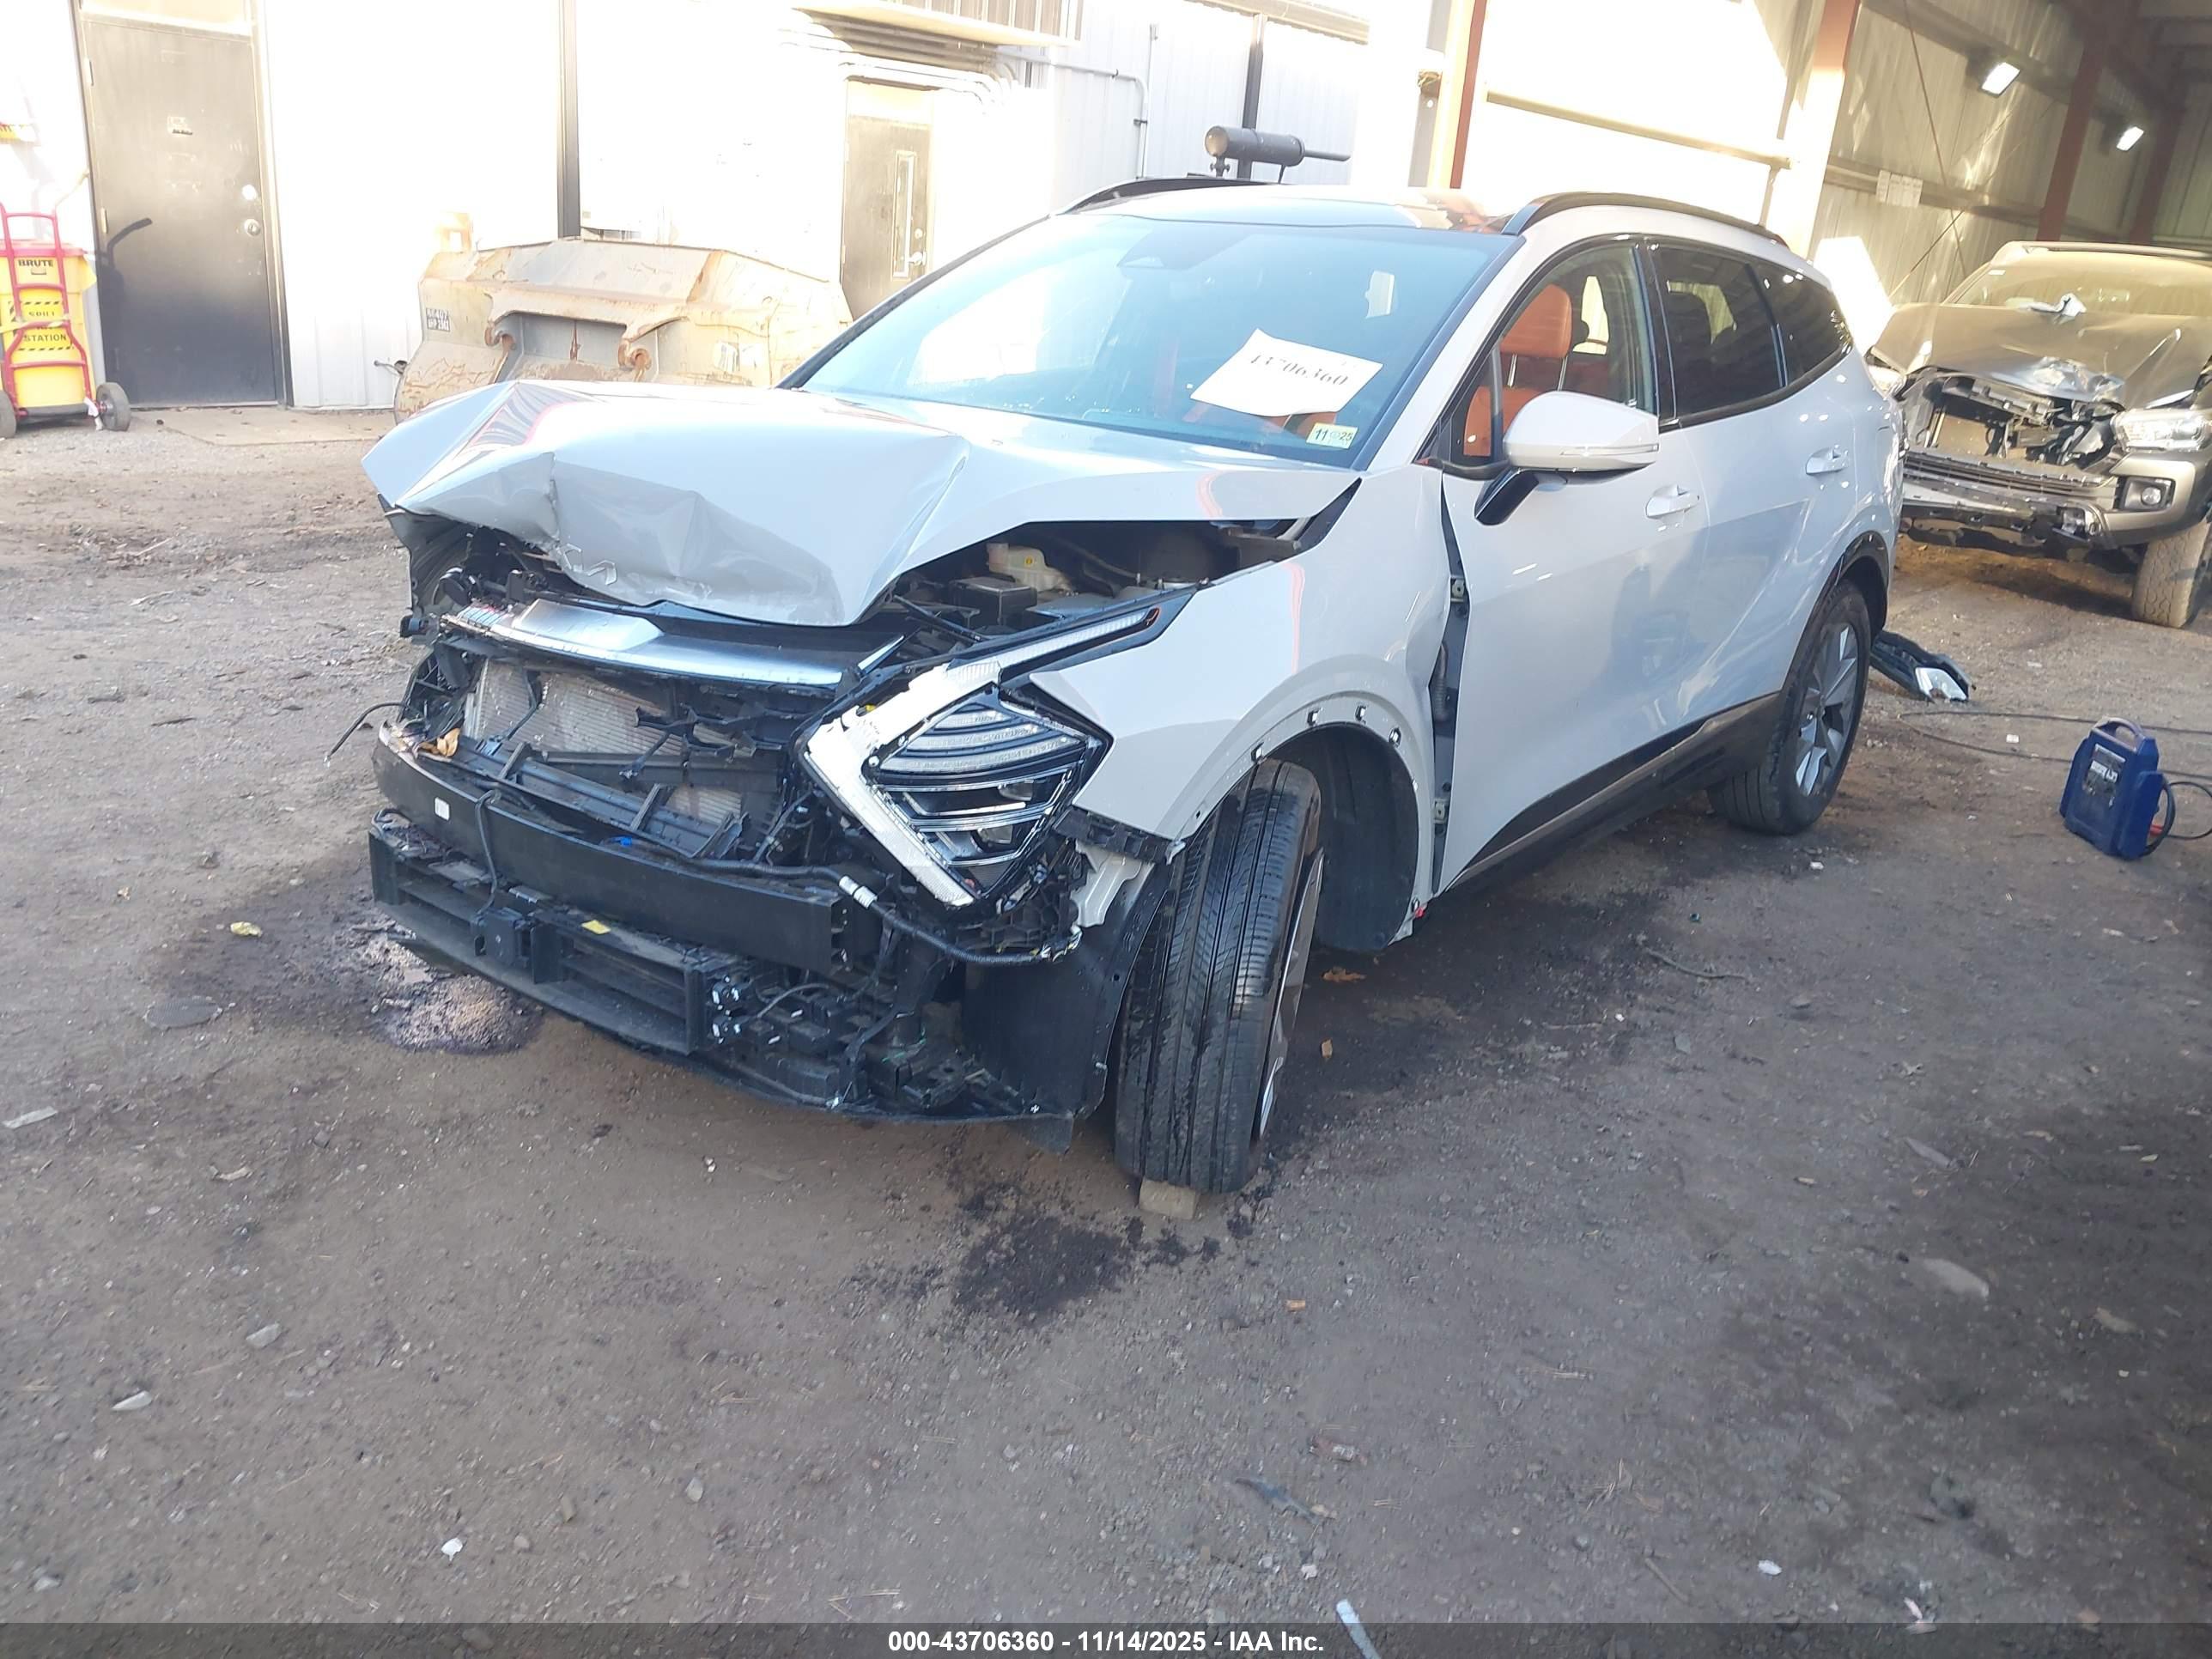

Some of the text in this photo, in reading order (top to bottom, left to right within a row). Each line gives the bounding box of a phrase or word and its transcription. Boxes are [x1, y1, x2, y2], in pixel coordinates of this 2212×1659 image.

[18, 258, 54, 267] BRUTE
[1315, 428, 1353, 441] 11 25
